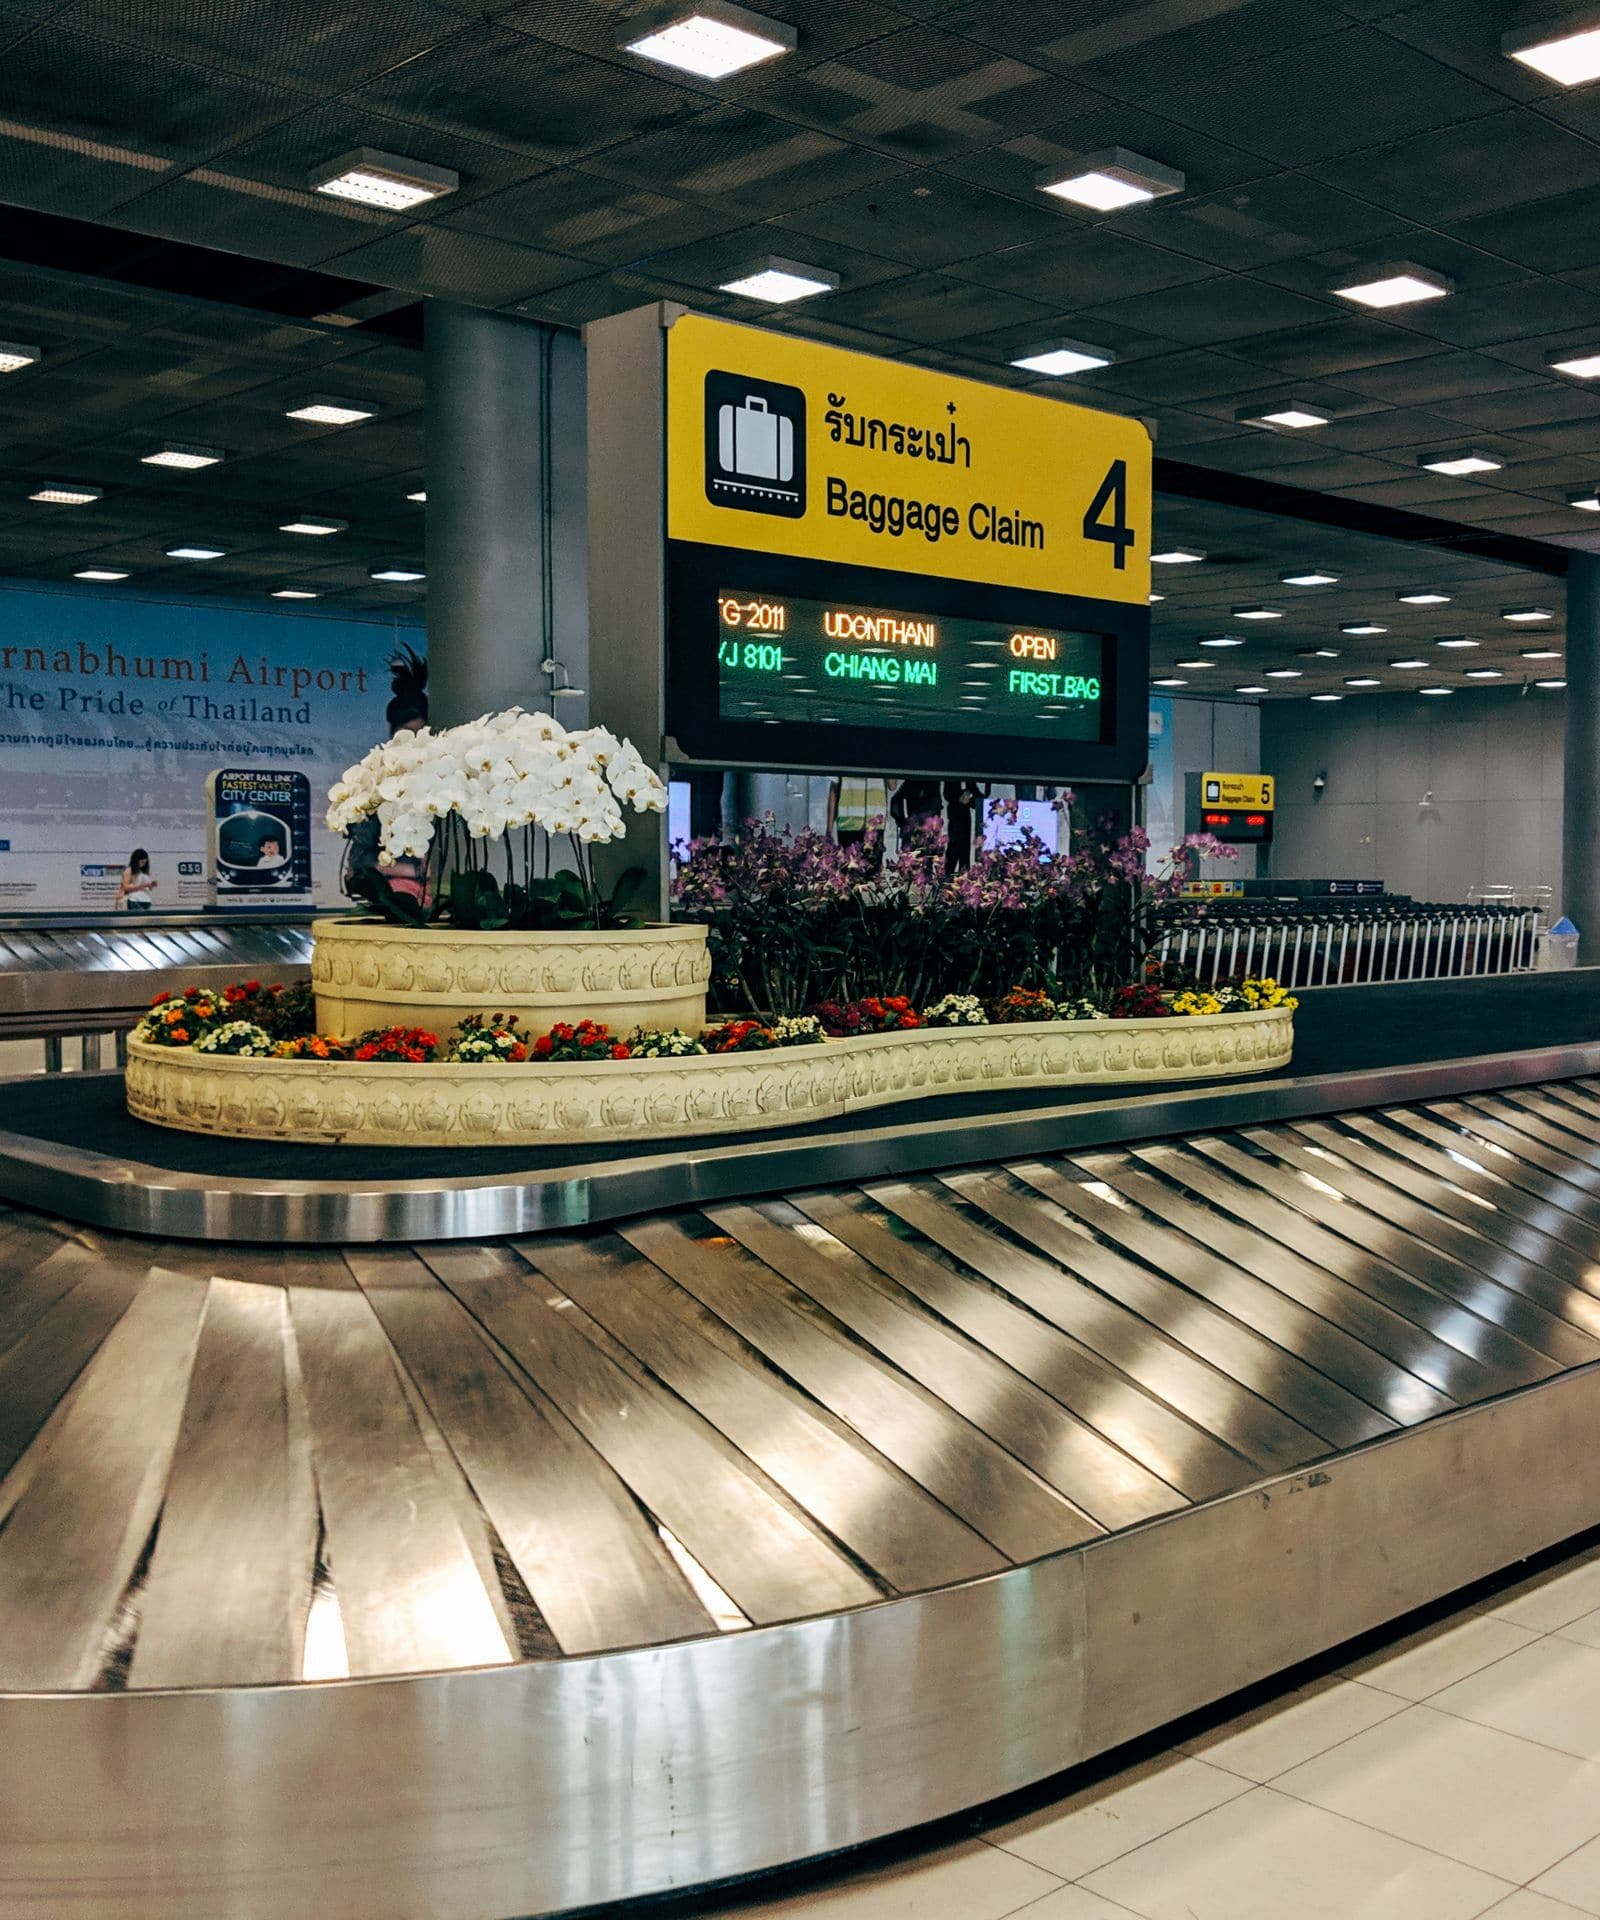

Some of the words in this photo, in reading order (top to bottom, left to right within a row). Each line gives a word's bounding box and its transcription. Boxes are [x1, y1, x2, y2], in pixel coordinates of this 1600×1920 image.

[824, 392, 971, 468] รับกระเป๋า
[826, 476, 960, 542] Baggage
[968, 502, 1045, 550] Claim
[1082, 458, 1136, 571] 4
[717, 598, 742, 626] G
[746, 602, 785, 631] 2011
[824, 610, 935, 648] UDONTHANI
[1009, 633, 1056, 661] OPEN
[1, 641, 210, 683] rnabhumi
[226, 655, 369, 699] Airport
[743, 643, 783, 671] 8101
[824, 652, 901, 683] CHIANG
[903, 659, 938, 686] MAI
[1009, 670, 1061, 697] FIRST
[1063, 675, 1101, 701] BAG
[0, 682, 46, 711] he
[57, 687, 145, 716] Pride
[157, 695, 179, 712] of
[182, 694, 312, 725] Thailand
[221, 790, 247, 801] CITY
[249, 791, 292, 802] CENTER
[222, 773, 255, 781] AIRPORT
[222, 781, 257, 790] FASTEST
[1260, 783, 1271, 805] 5
